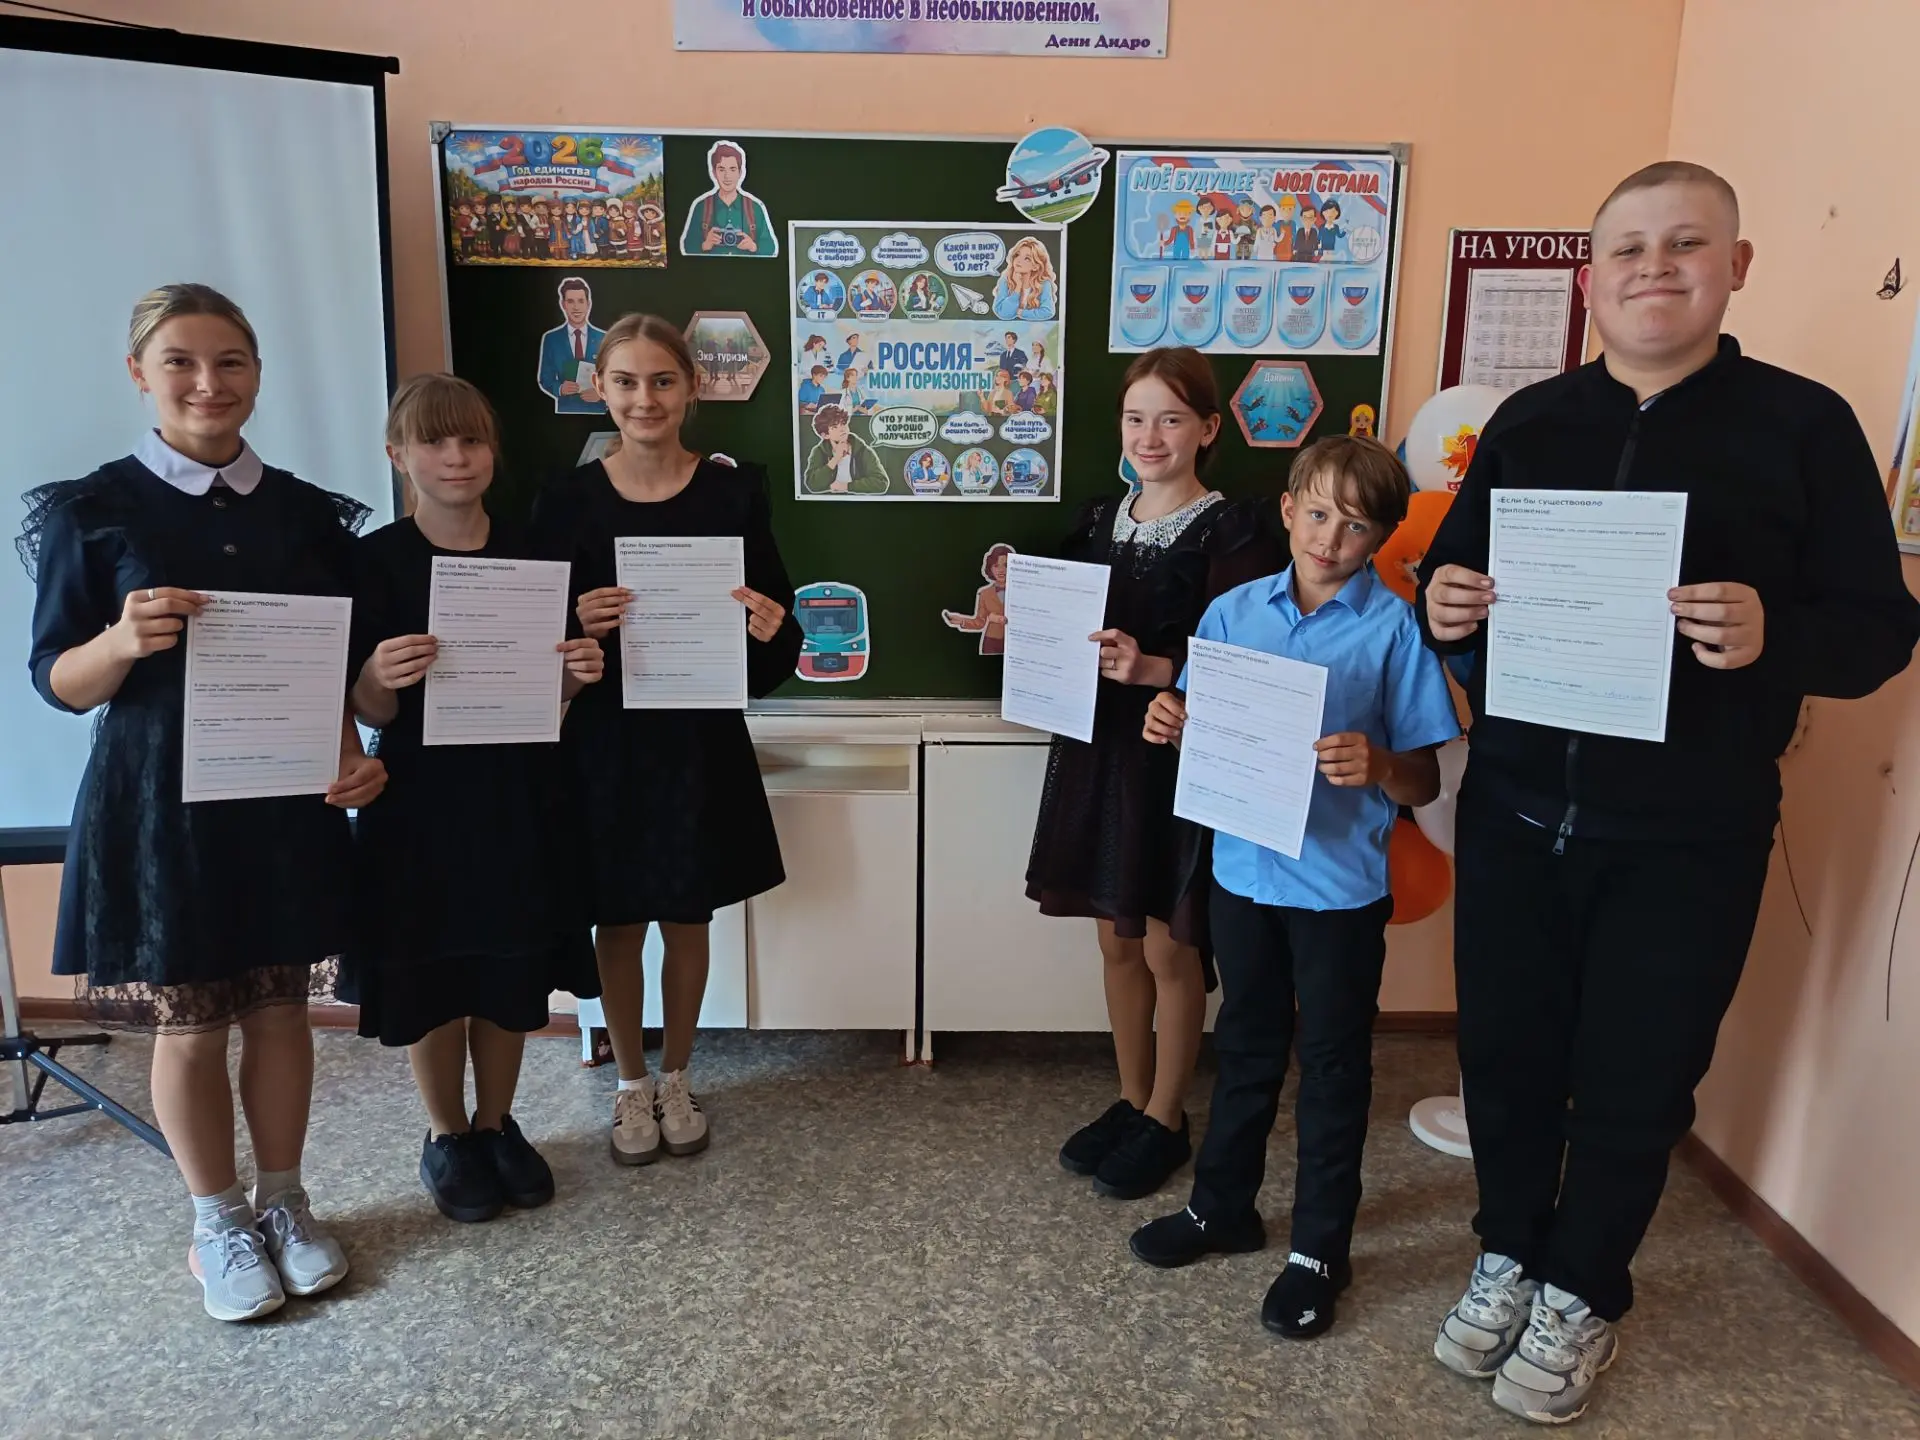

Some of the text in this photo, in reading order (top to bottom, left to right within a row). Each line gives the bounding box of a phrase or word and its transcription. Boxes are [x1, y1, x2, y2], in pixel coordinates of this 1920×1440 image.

[760, 0, 905, 19] обыкновенное
[909, 0, 921, 19] в
[925, 0, 1100, 22] необыкновенном.
[1045, 34, 1151, 50] Дени Дидро
[499, 135, 605, 167] 2026
[511, 165, 591, 177] Год единства
[513, 176, 591, 187] народов России
[1133, 165, 1171, 191] МОЁ
[1174, 168, 1255, 193] БУДУЩЕЕ
[1273, 172, 1313, 193] МОЯ
[1316, 172, 1379, 194] СТРАНА
[944, 242, 970, 252] Какой
[978, 243, 1000, 252] вижу
[1458, 235, 1590, 260] НА УРОКЕ
[947, 252, 996, 262] себя через
[953, 260, 990, 271] 10 лет?
[697, 349, 748, 363] Эко-туризм
[868, 371, 991, 390] МОИ ГОРИЗОНТЫ
[879, 414, 929, 423] ЧТО У МЕНЯ
[885, 423, 924, 432] ХОРОШО
[878, 430, 932, 440] ПОЛУЧАЕТСЯ?
